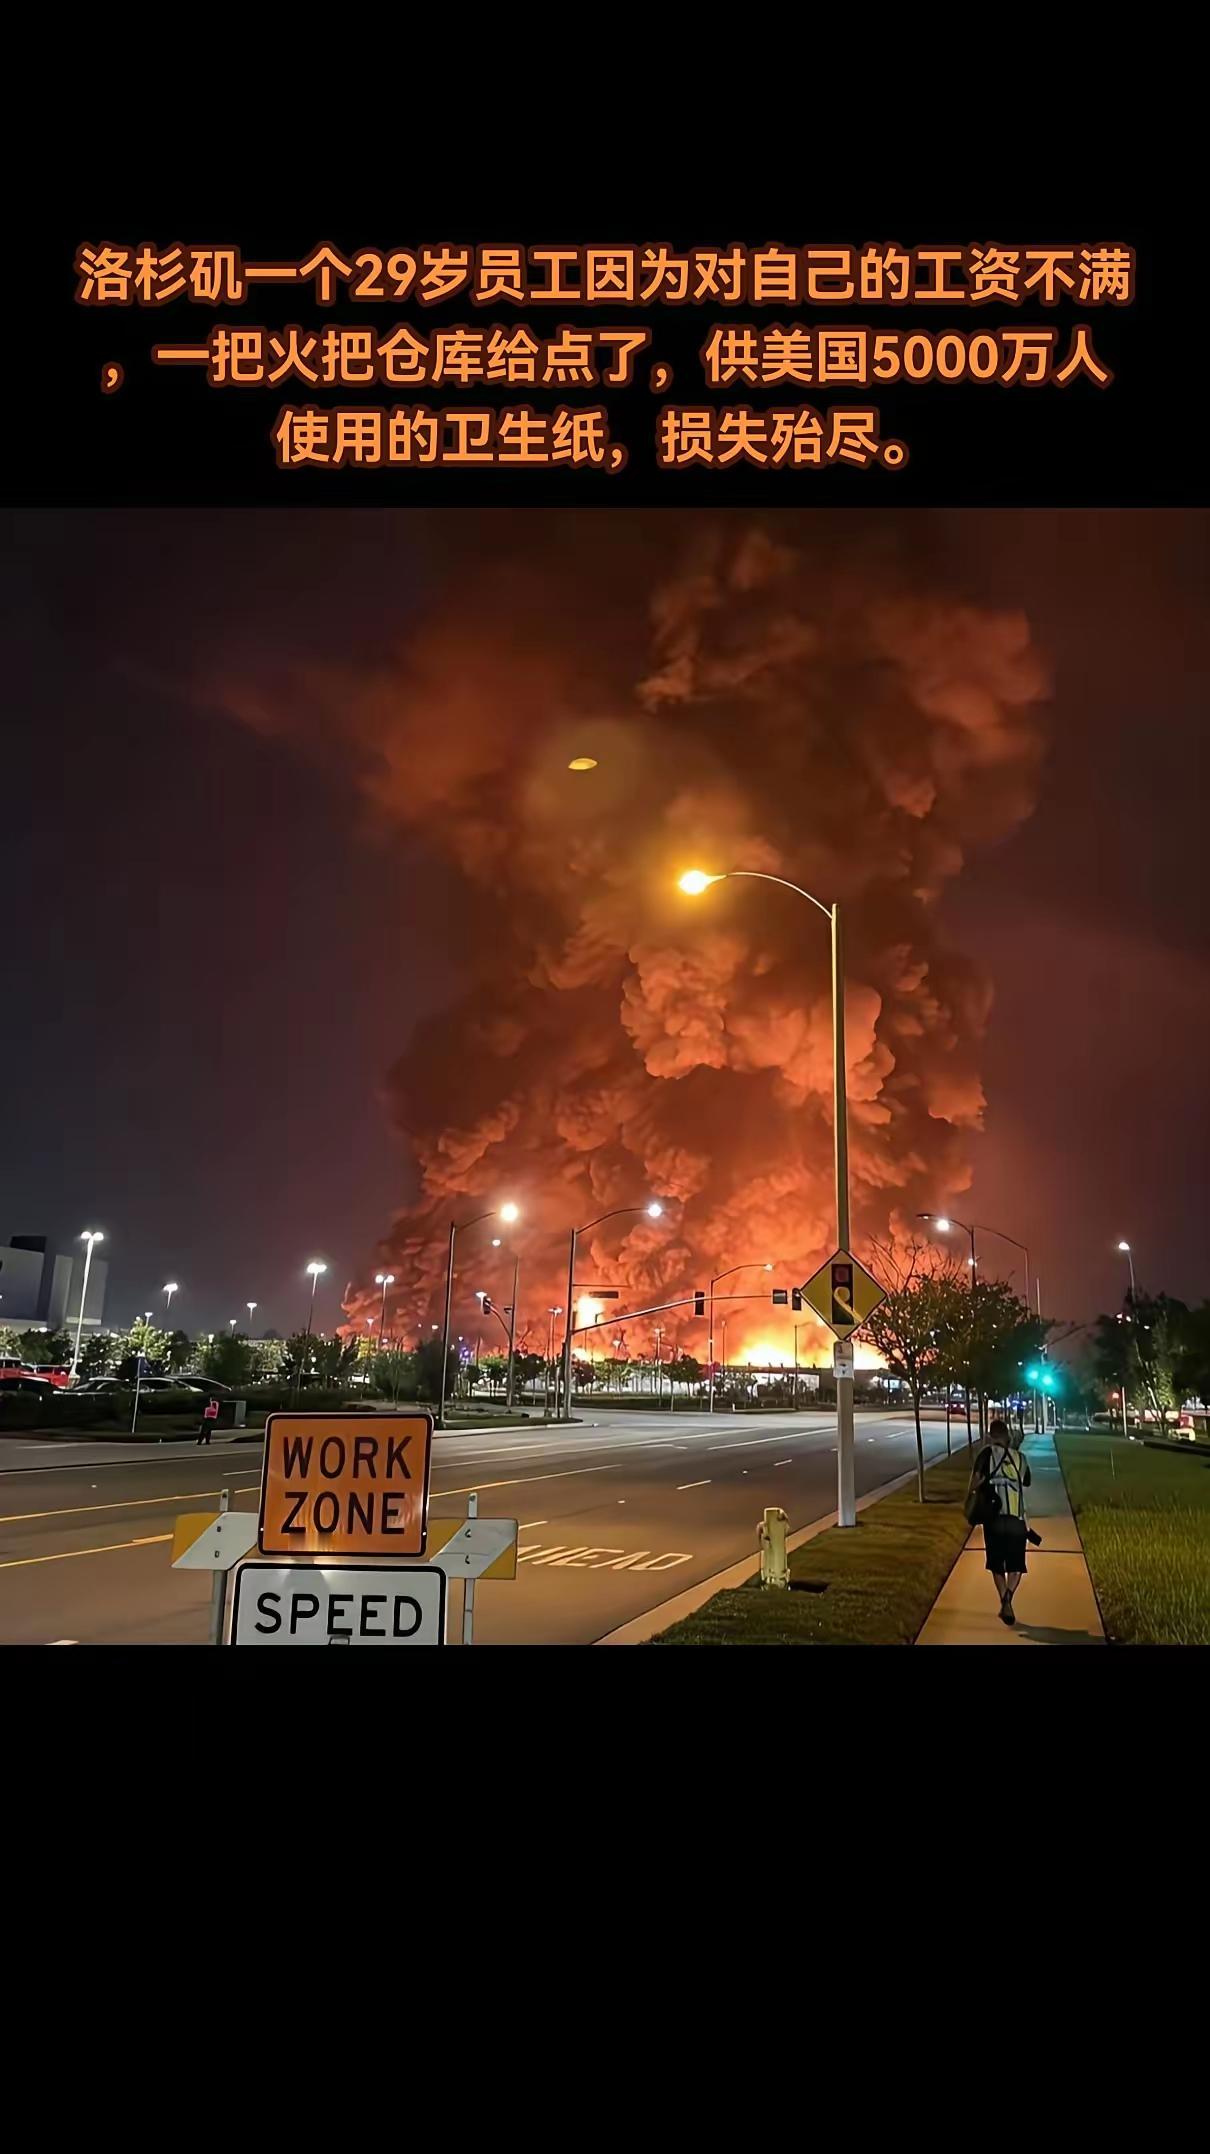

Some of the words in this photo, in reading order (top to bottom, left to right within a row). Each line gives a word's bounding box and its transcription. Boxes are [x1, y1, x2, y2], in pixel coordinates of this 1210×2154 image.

[283, 1436, 412, 1479] WORK
[281, 1491, 405, 1535] ZONE
[254, 1592, 423, 1638] SPEED
